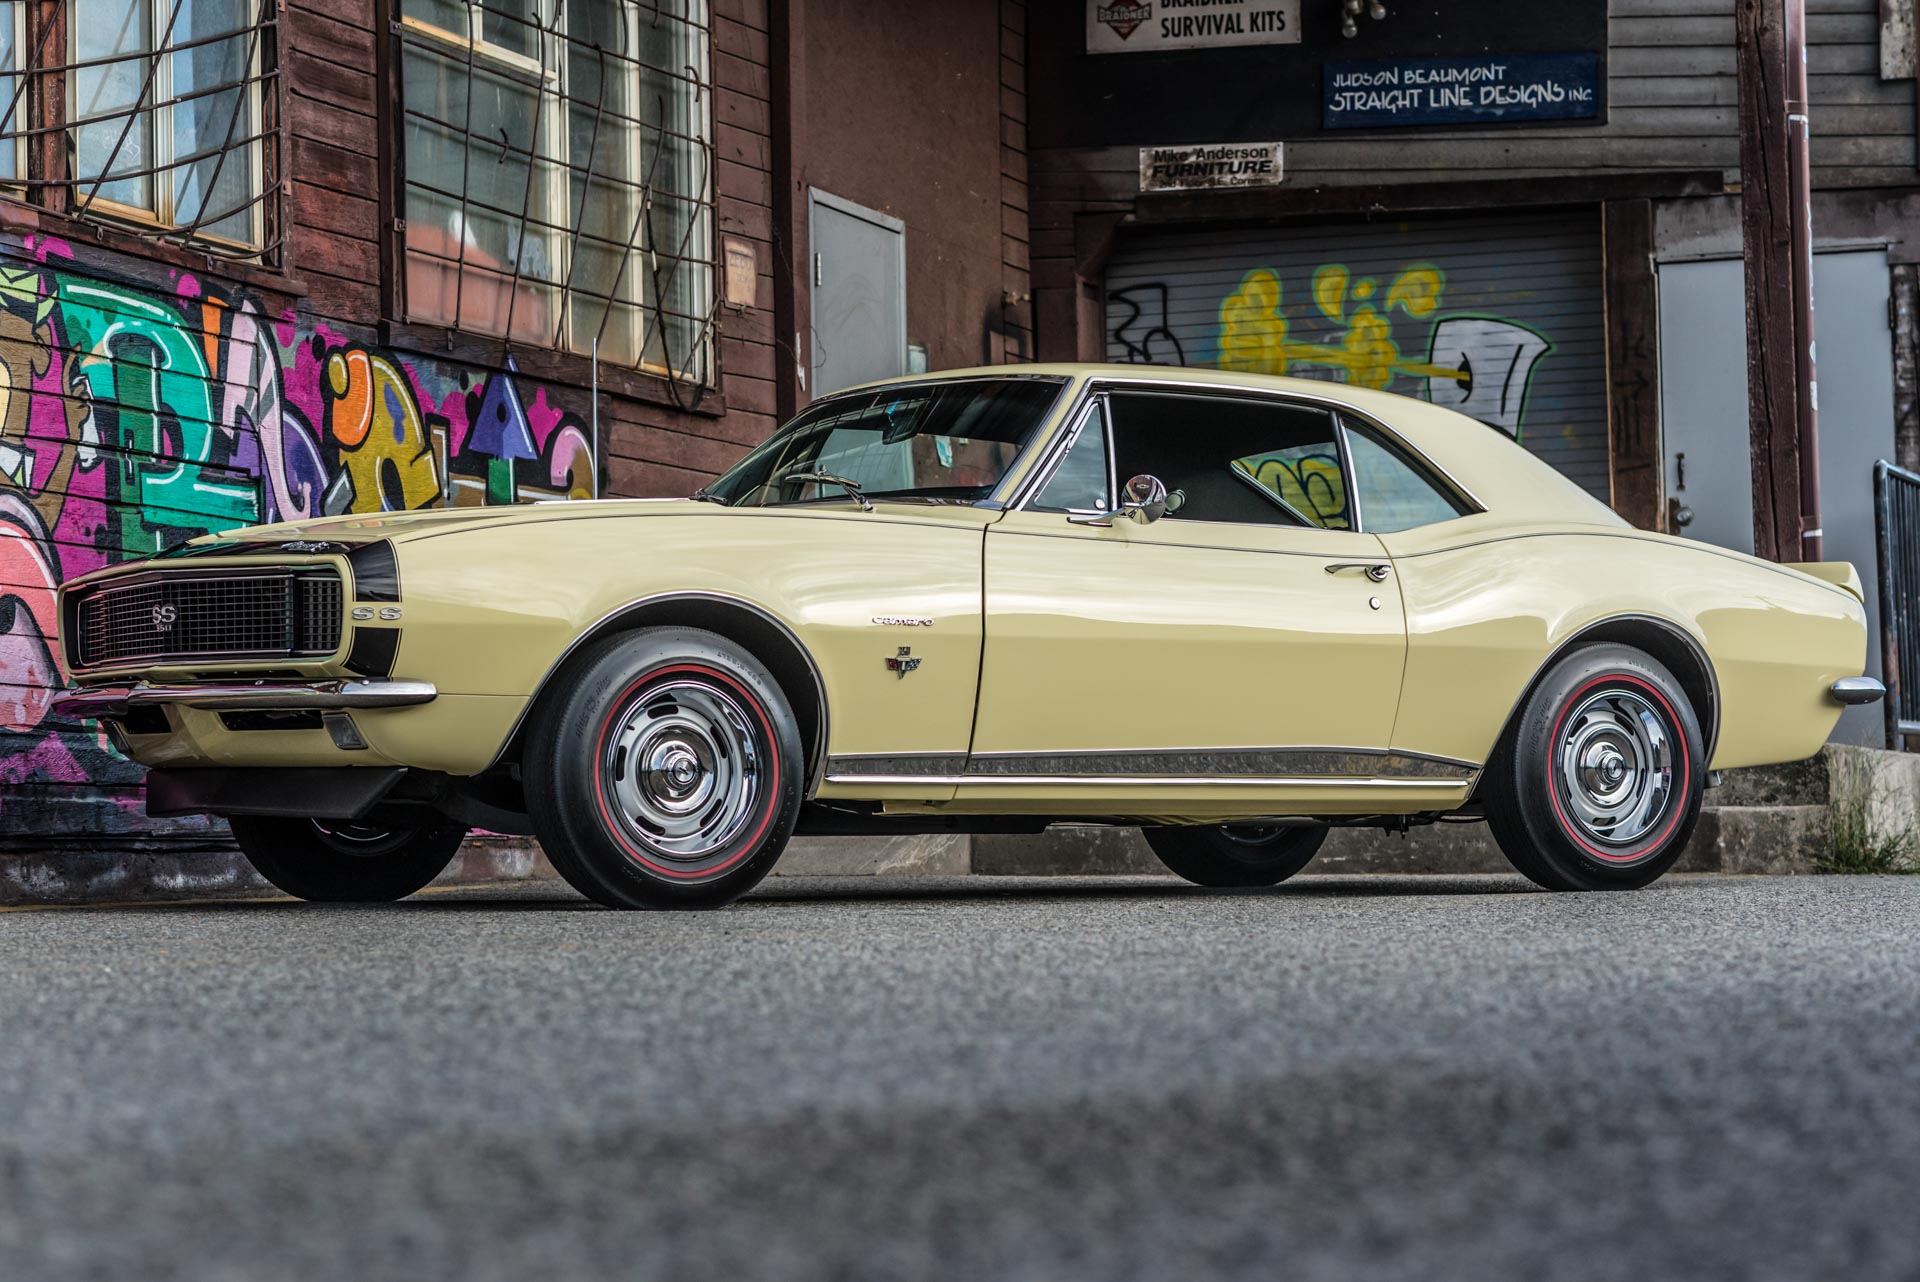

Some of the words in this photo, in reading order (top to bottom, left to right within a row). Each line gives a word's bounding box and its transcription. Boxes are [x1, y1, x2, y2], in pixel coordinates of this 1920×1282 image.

[1161, 12, 1244, 38] SURVIVAL
[1250, 10, 1286, 32] KITS
[1333, 67, 1398, 87] JUDSON
[1404, 63, 1507, 85] BEAUMONT
[1329, 89, 1423, 113] STRAIGHT
[1430, 84, 1473, 107] LINE
[1480, 80, 1565, 108] DESIGNS
[1154, 149, 1189, 162] Mike
[1196, 147, 1269, 160] Anderson
[1152, 160, 1273, 178] FURNITURE
[1230, 176, 1265, 185] Corner
[152, 604, 176, 623] SS
[352, 606, 402, 620] SS
[872, 617, 935, 627] Camaro
